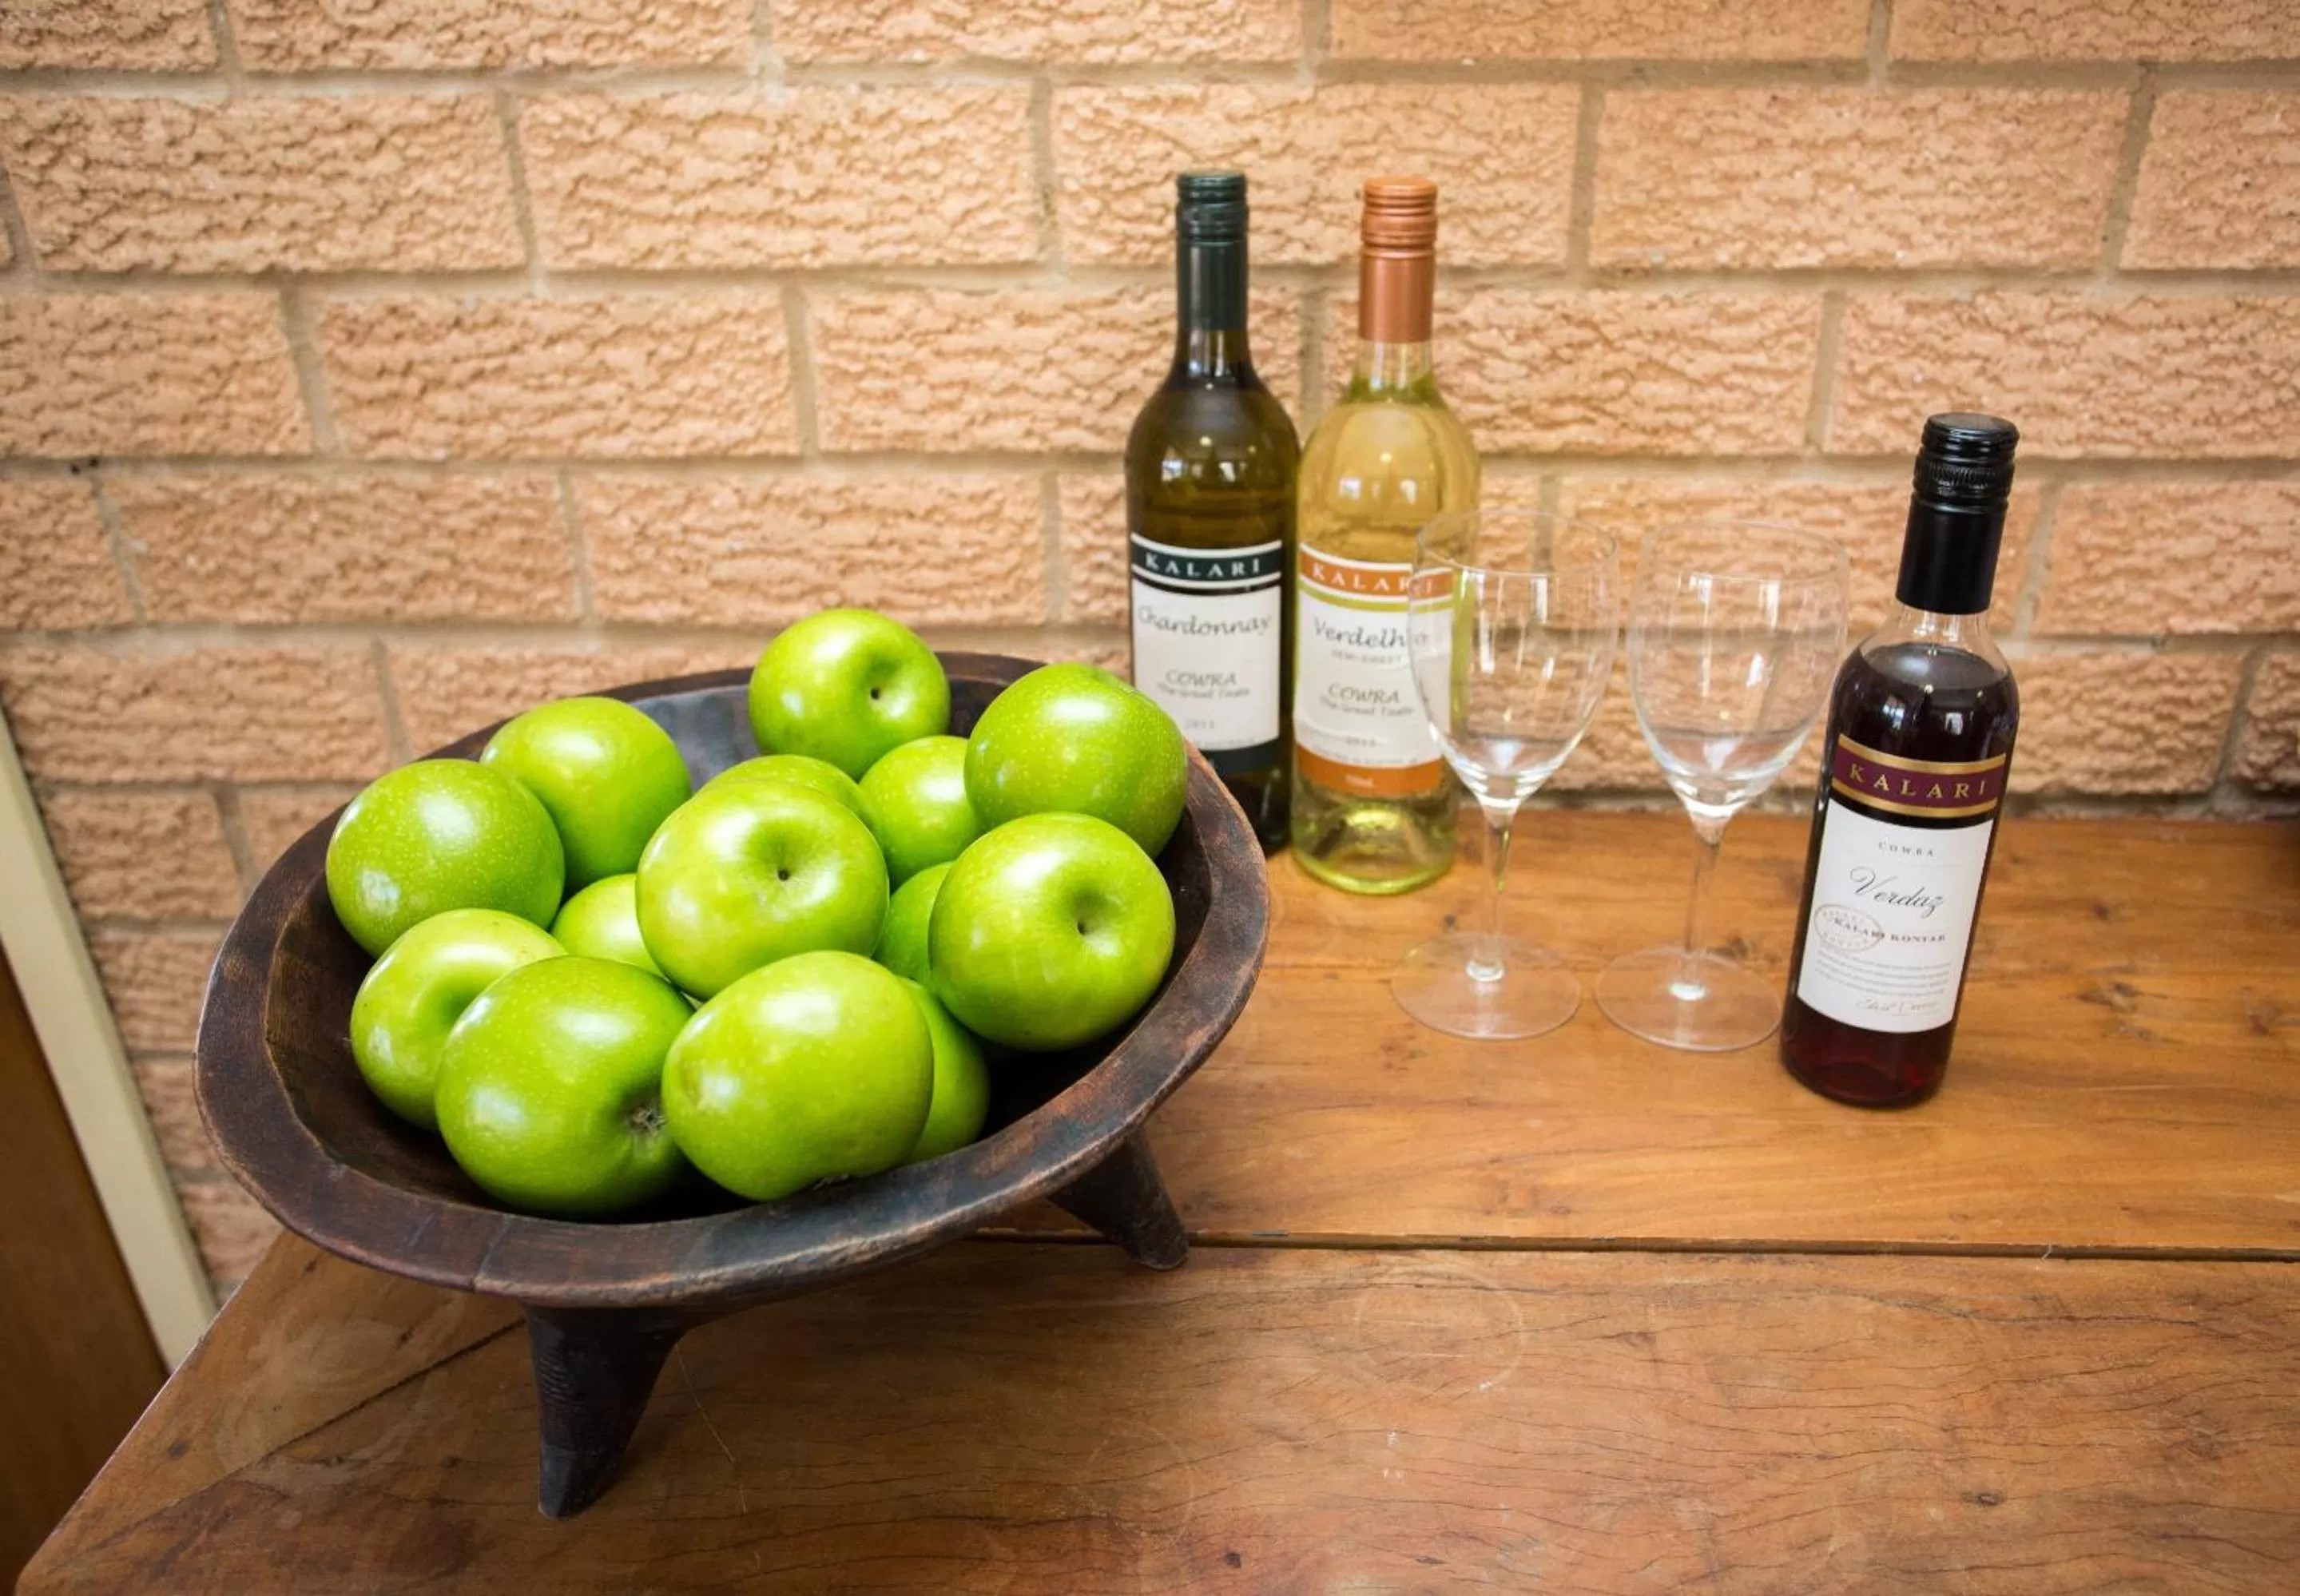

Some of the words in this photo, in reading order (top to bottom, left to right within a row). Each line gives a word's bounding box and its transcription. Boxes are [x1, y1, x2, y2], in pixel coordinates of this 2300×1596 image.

[1145, 553, 1260, 578] KALARI
[1138, 604, 1272, 636] Chardonnay
[1165, 669, 1237, 686] COWRA
[1328, 682, 1400, 703] COWRA
[1849, 763, 1985, 799] KALARI
[1878, 841, 1934, 856] COWRA
[1849, 866, 1944, 919] Verdaz
